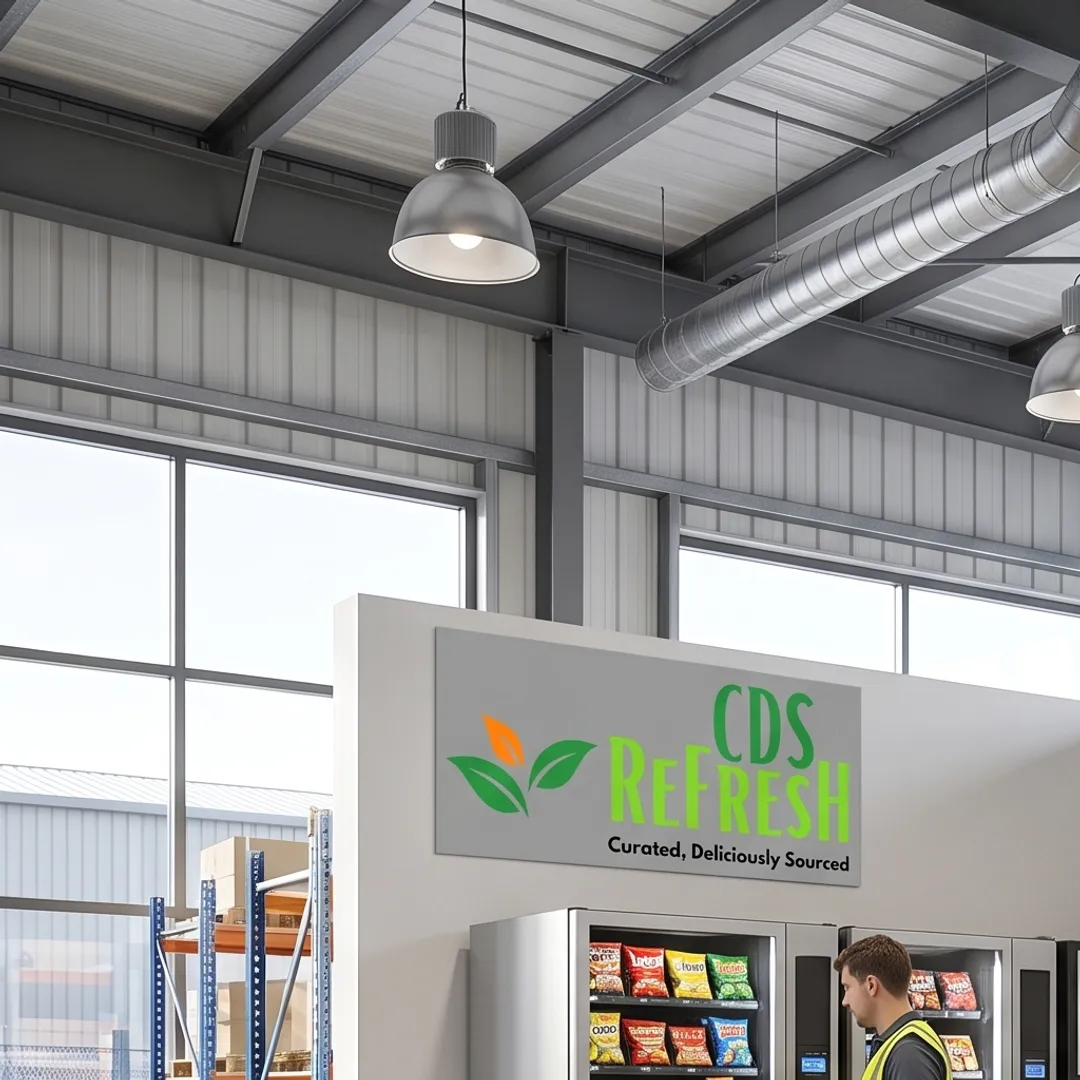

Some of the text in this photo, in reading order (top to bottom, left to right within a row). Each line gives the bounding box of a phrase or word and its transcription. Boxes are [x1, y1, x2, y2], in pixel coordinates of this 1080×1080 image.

[713, 684, 815, 769] CDS
[608, 836, 850, 872] Curated, Deliciously Sourced
